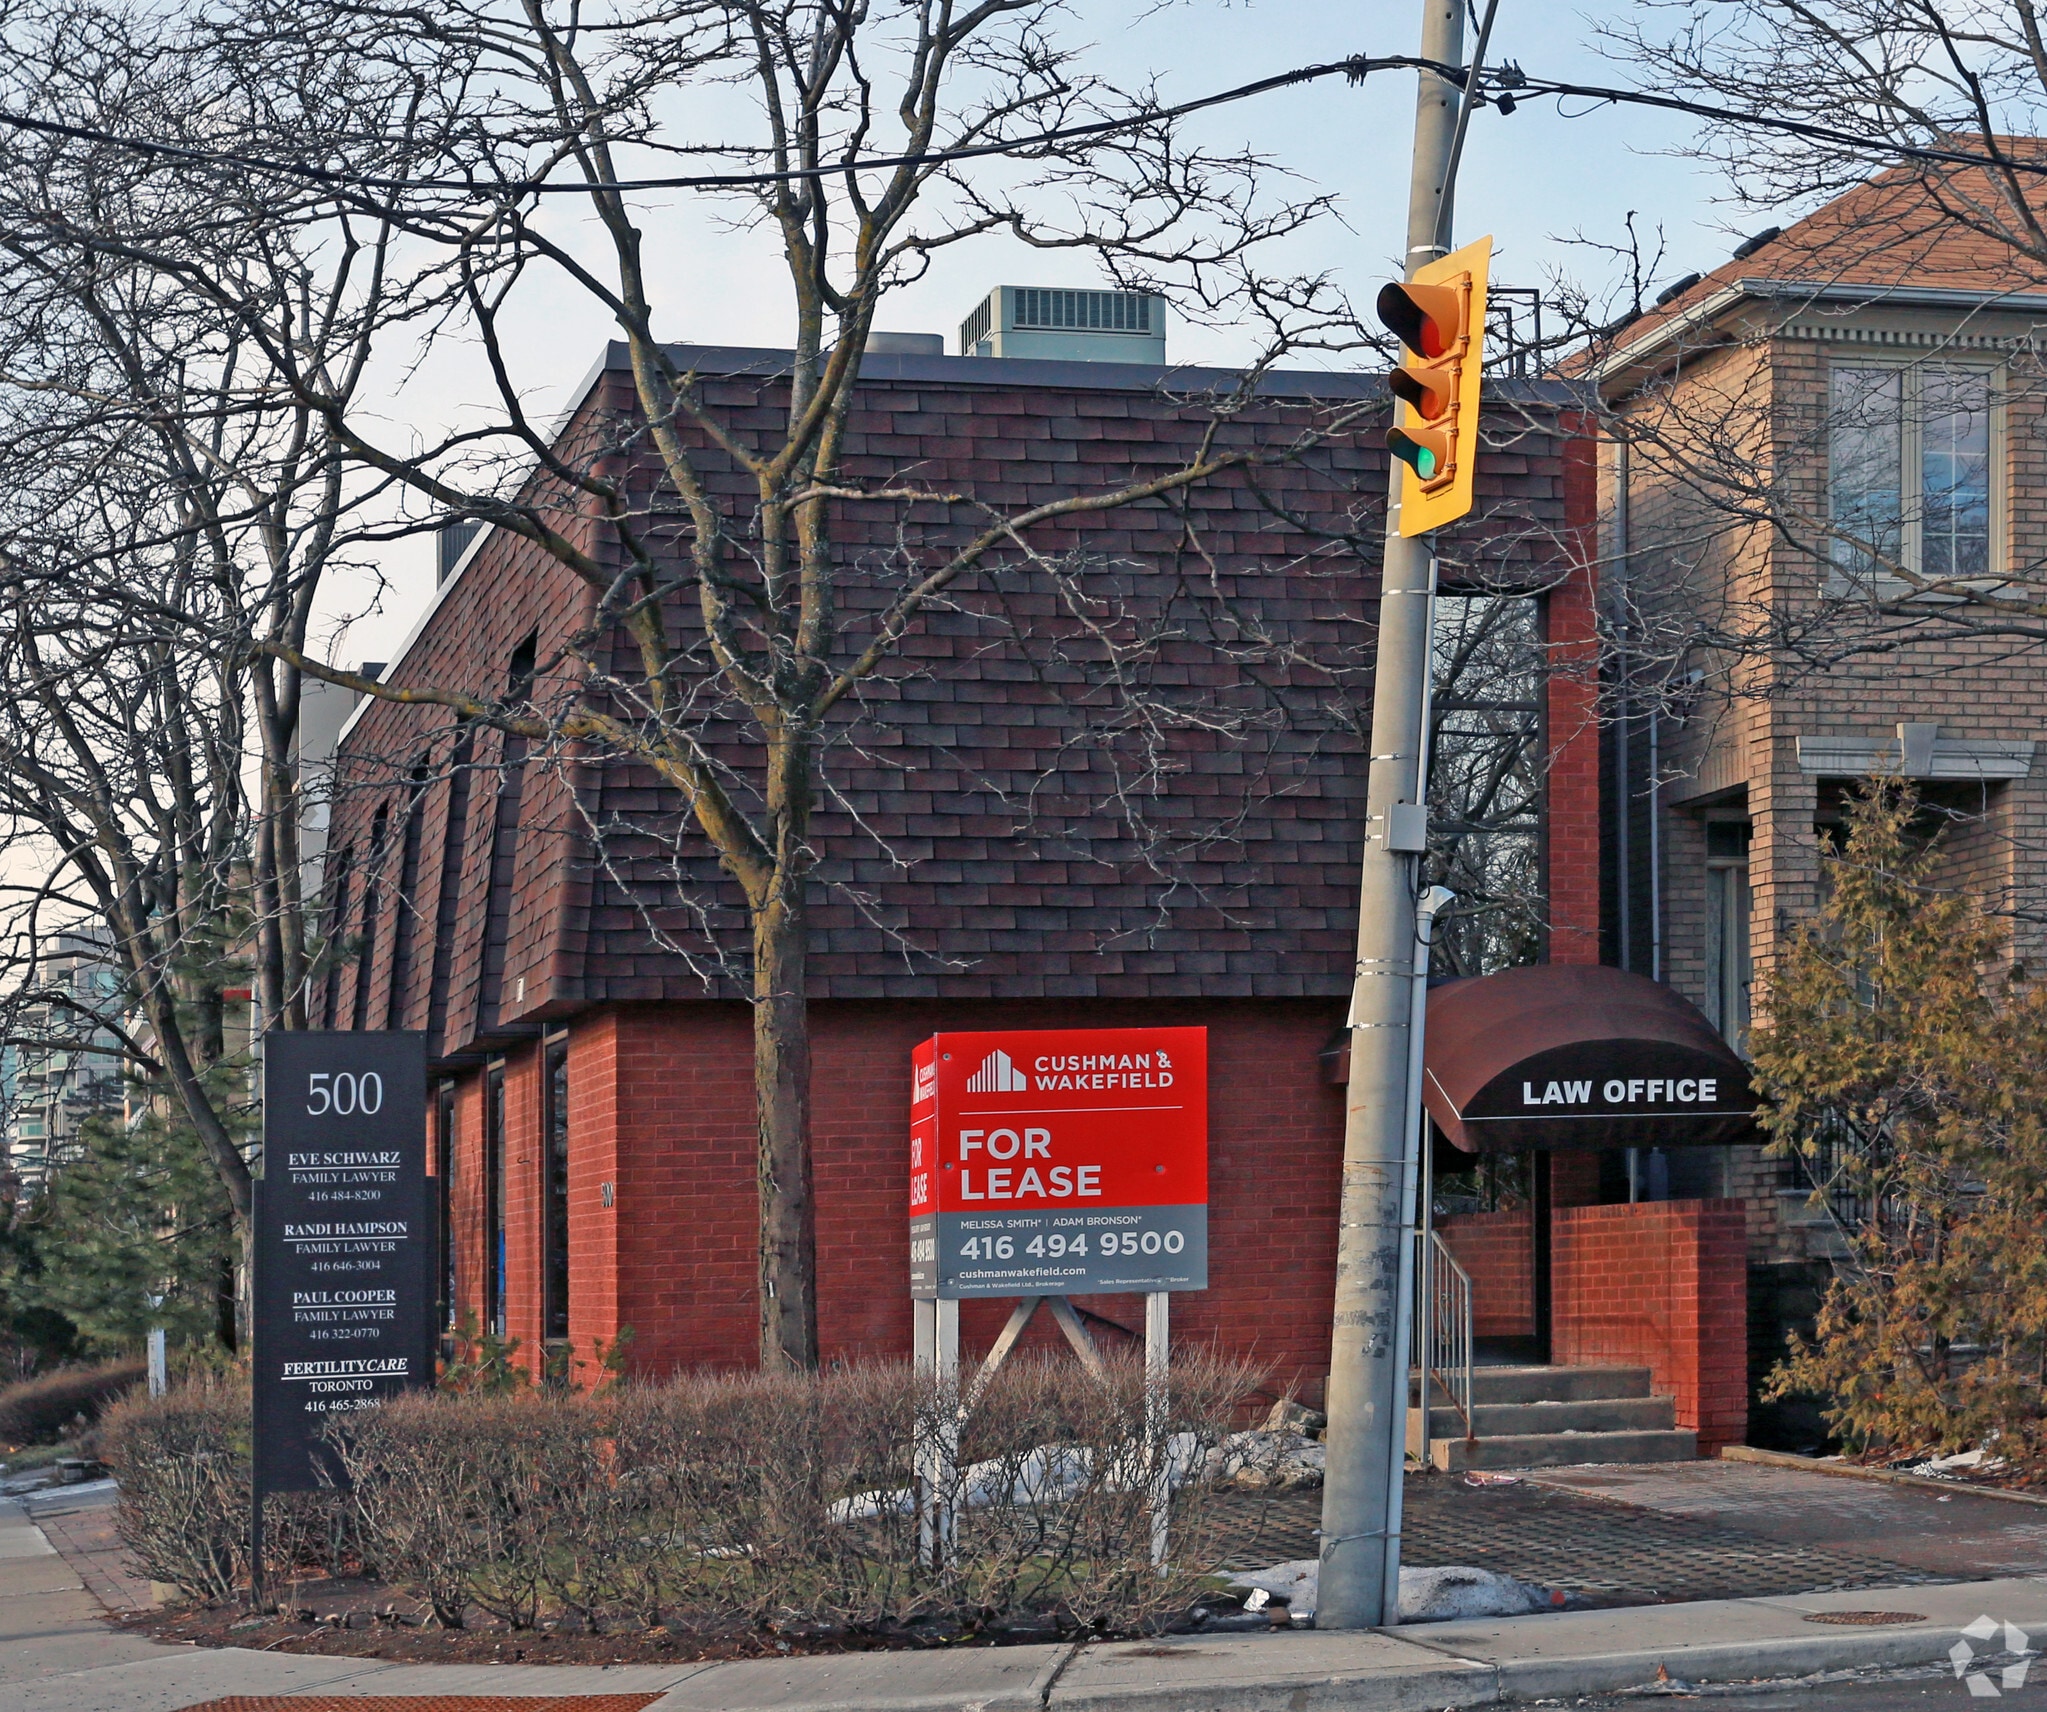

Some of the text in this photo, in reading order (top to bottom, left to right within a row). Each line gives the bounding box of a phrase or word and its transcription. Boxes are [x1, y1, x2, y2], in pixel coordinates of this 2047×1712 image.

[1034, 1052, 1172, 1072] CUSHMAN &
[1034, 1072, 1174, 1091] WAKEFIELD
[306, 1072, 382, 1115] 500
[1523, 1078, 1717, 1105] LAW OFFICE
[959, 1127, 1052, 1161] FOR
[288, 1152, 400, 1166] EVE SCHWARZ
[292, 1172, 396, 1184] FAMILY LAWYER
[960, 1165, 1102, 1200] LEASE
[308, 1190, 381, 1201] 416 484-8200
[284, 1222, 408, 1236] RANDI HAMPSON
[960, 1220, 1004, 1229] MELISSA
[1053, 1218, 1083, 1227] ADAM
[296, 1242, 396, 1254] FAMILY LAWYER
[960, 1230, 1184, 1260] 416 494 9500
[311, 1260, 381, 1272] 416 646-3004
[959, 1266, 1086, 1280] cushmanwakefield.com
[293, 1290, 396, 1304] PAUL COOPER
[294, 1310, 394, 1322] FAMILY LAWYER
[309, 1328, 380, 1339] 416 322-0770
[284, 1358, 408, 1375] FERTILITYCARE
[309, 1380, 373, 1392] TORONTO
[304, 1400, 326, 1412] 416
